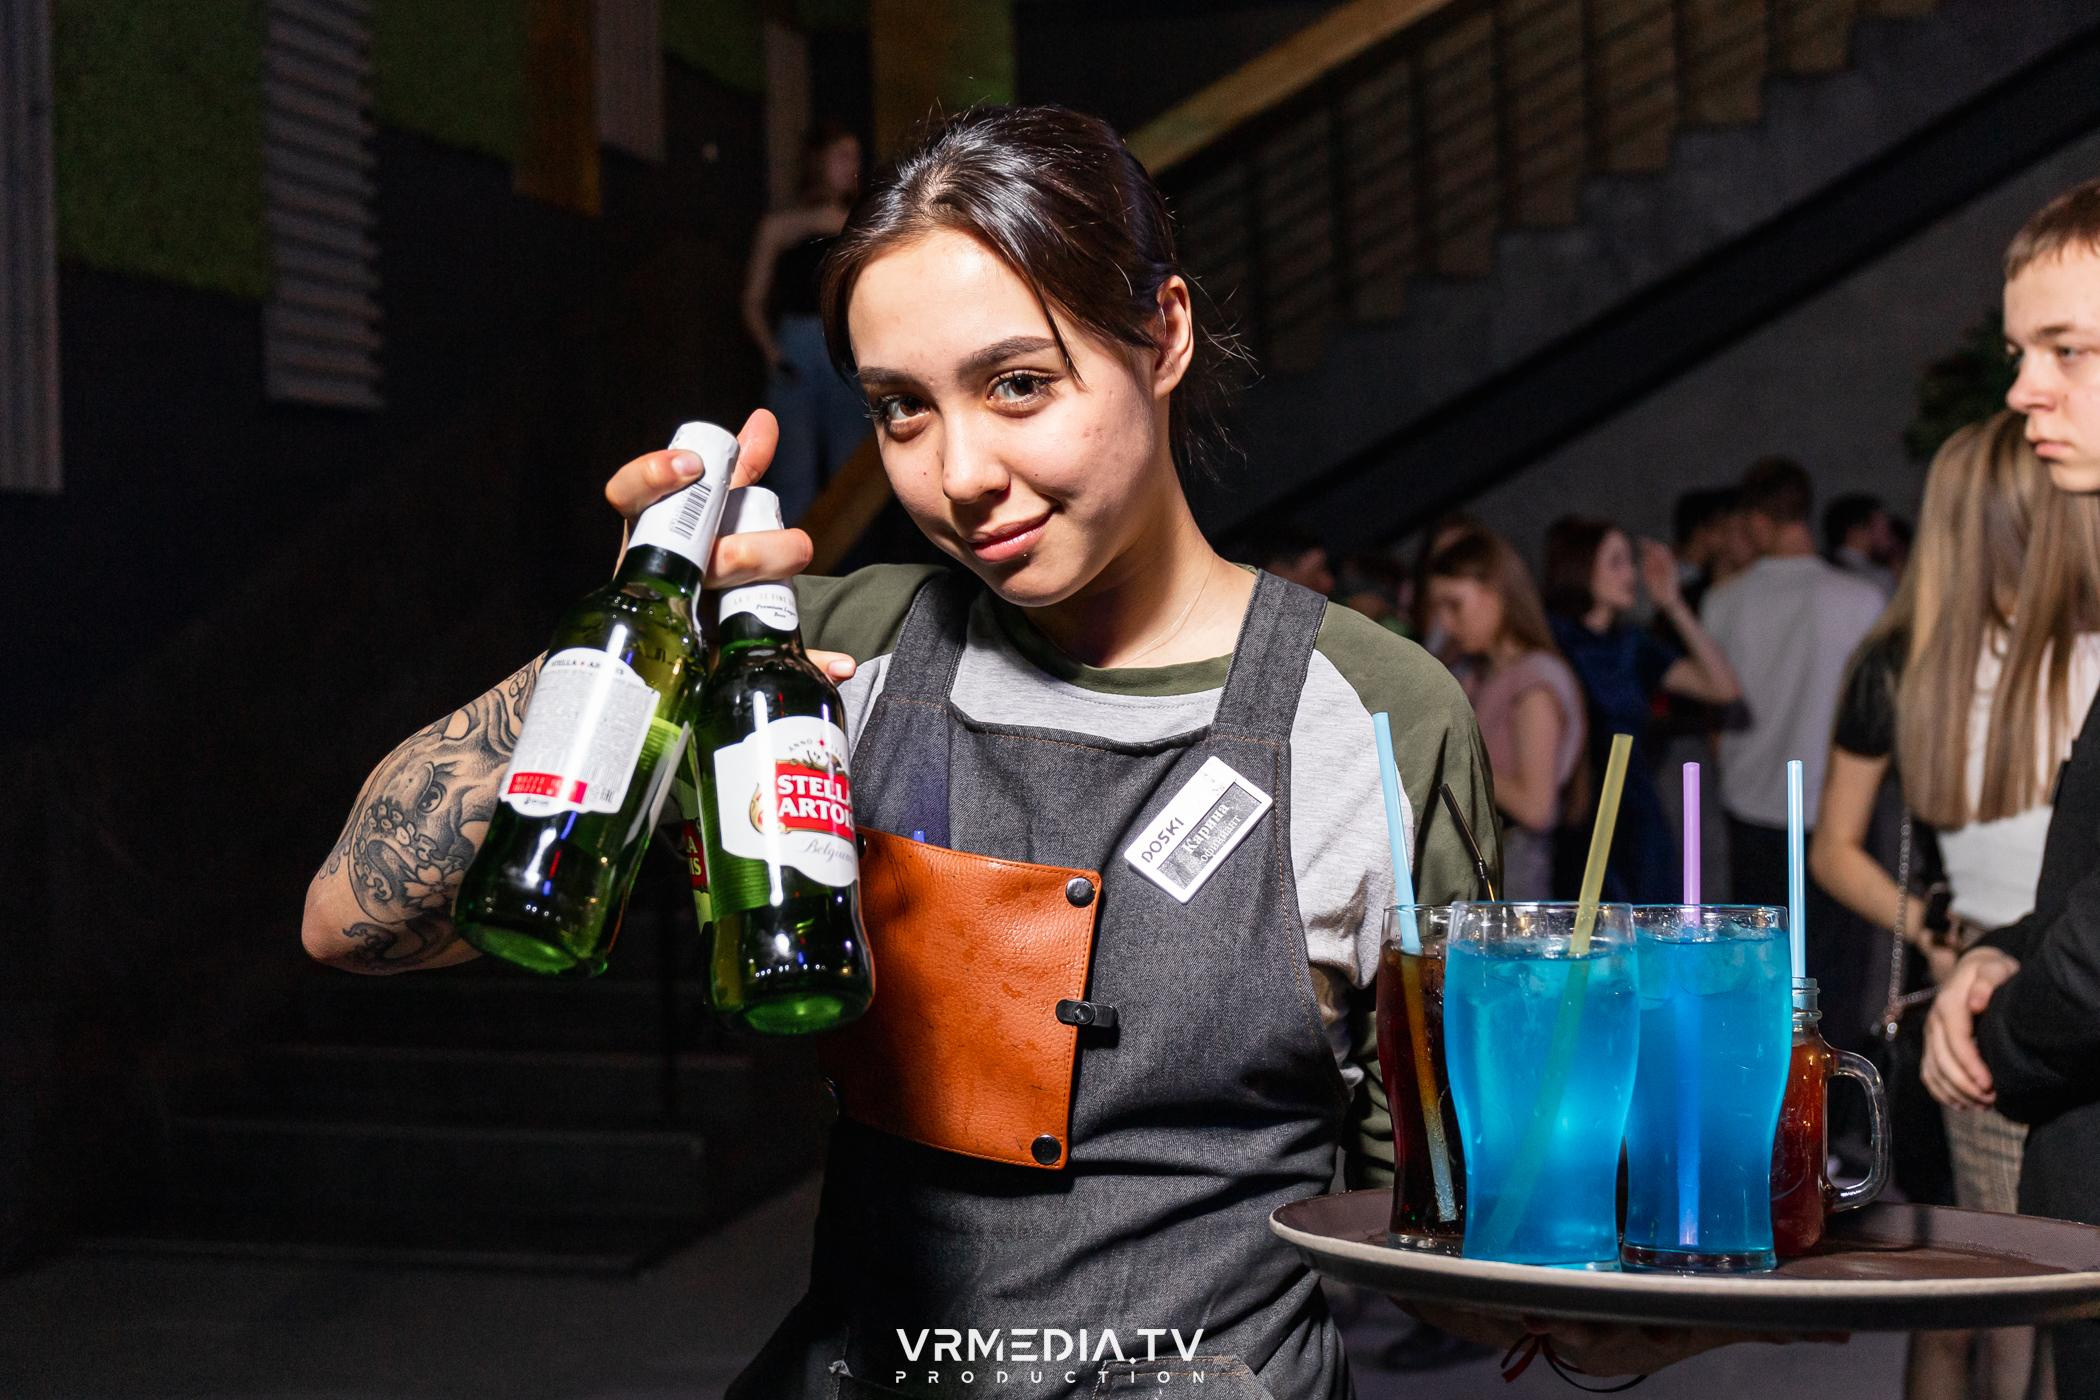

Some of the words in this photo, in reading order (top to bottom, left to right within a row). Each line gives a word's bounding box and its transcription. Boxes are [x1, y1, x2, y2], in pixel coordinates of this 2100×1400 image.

[1141, 817, 1184, 863] DOSKI
[1182, 803, 1230, 853] Карина
[1200, 815, 1242, 862] официант
